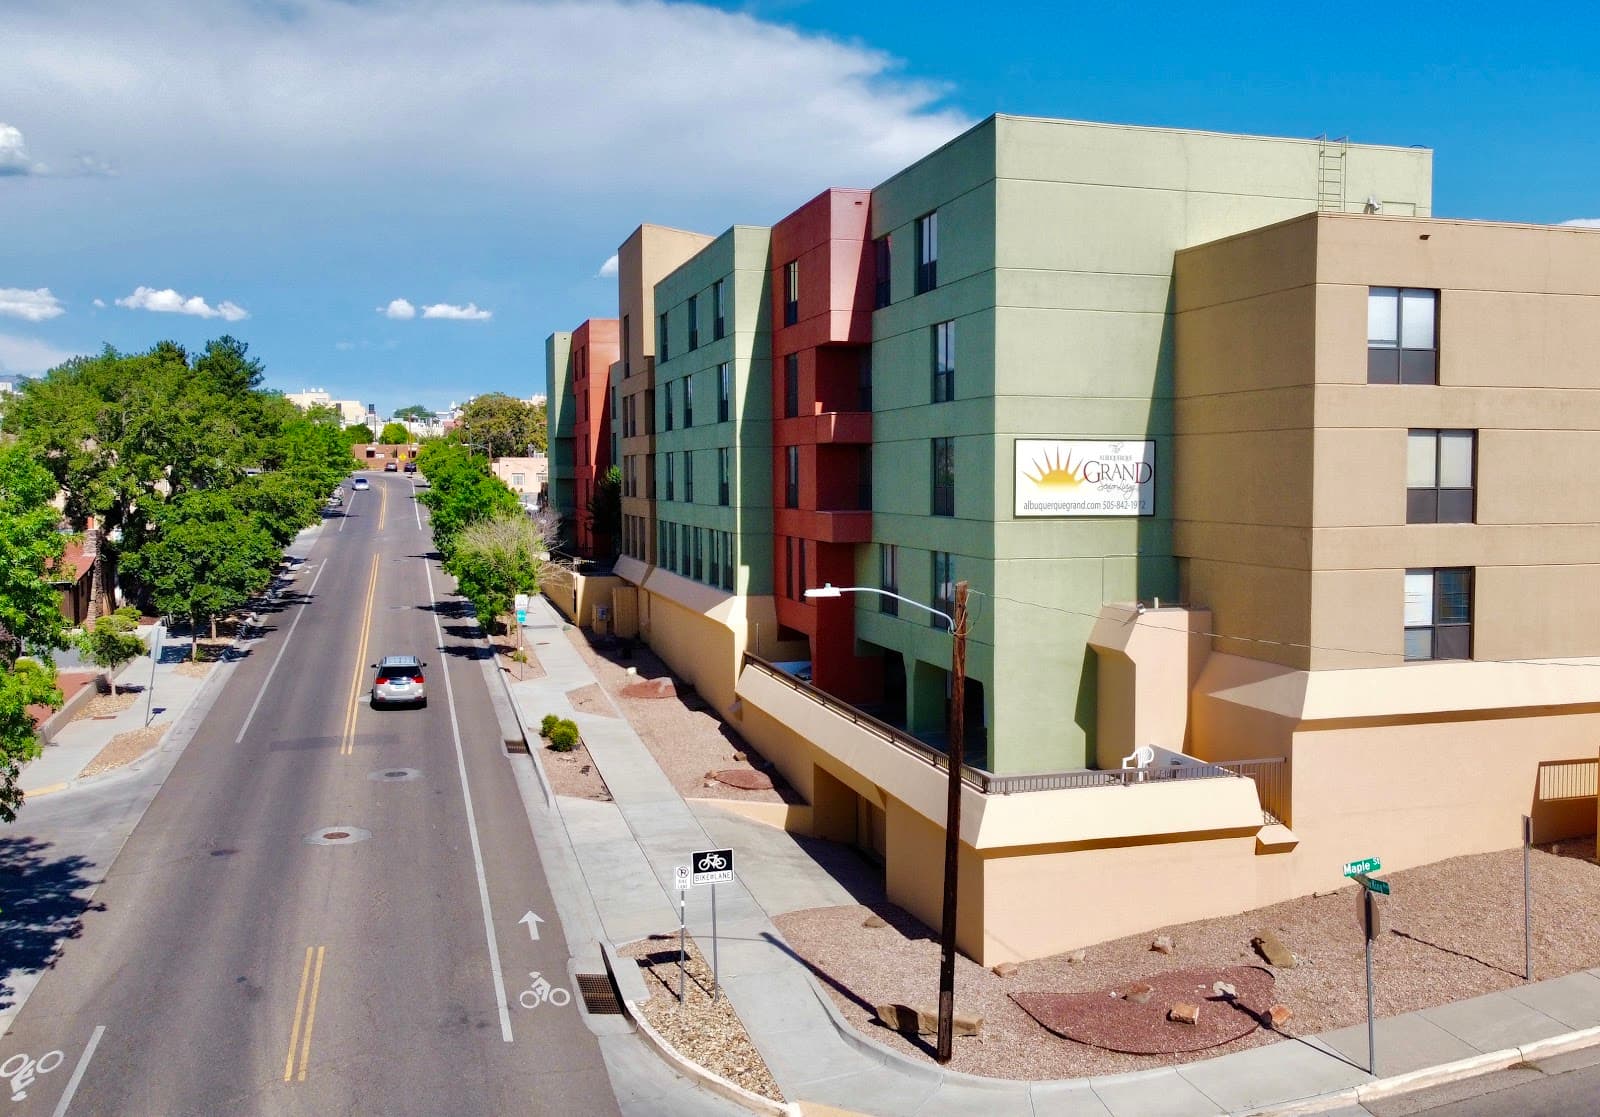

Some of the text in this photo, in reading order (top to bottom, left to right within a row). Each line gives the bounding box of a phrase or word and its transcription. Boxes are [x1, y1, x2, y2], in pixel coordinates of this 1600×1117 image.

[1083, 460, 1153, 484] GRAND
[1023, 500, 1101, 512] albuquerquegrand.com
[1343, 856, 1380, 874] Maple St
[695, 872, 731, 882] BIKE LANE
